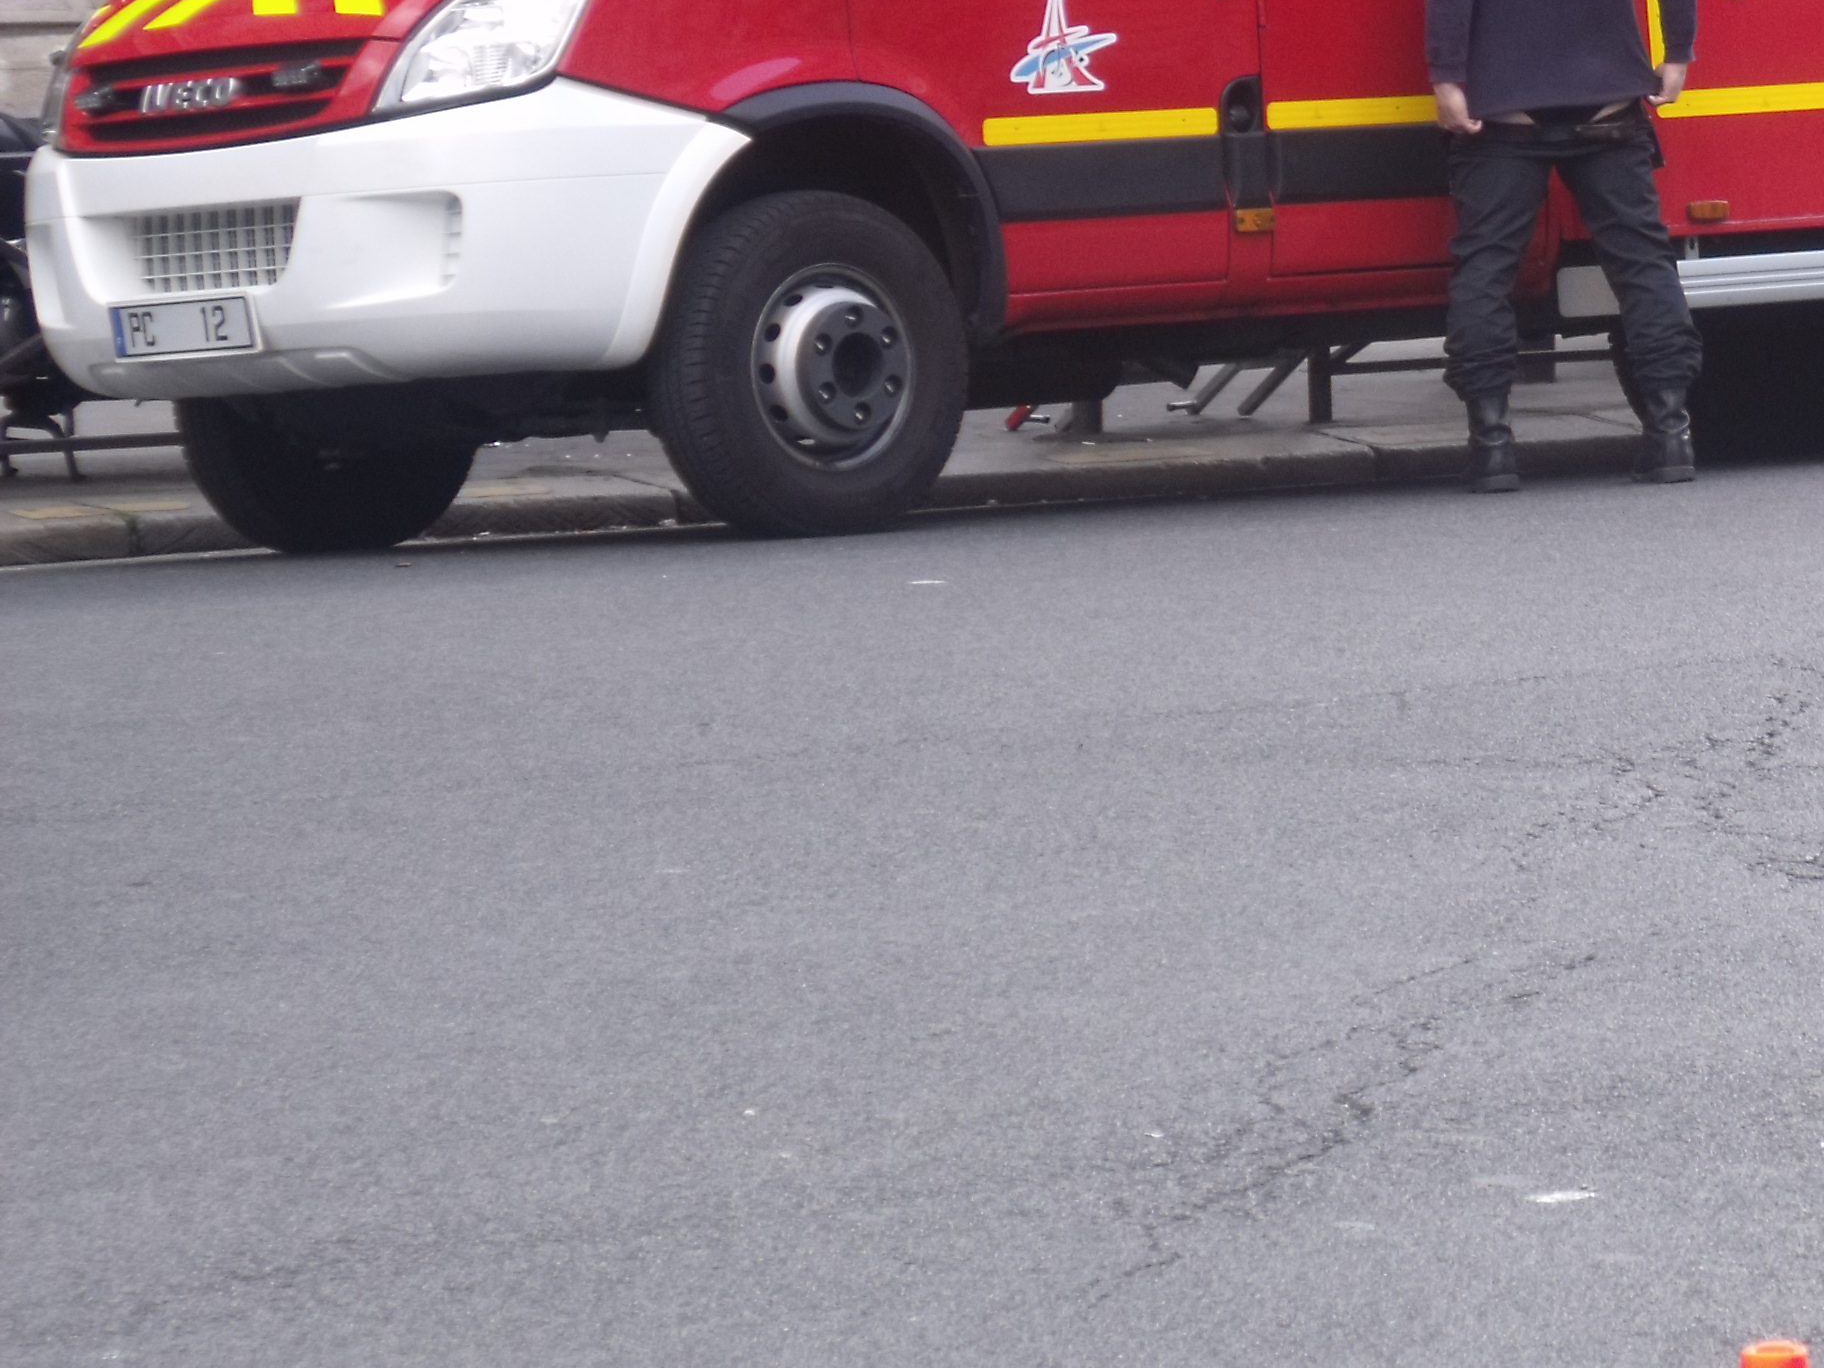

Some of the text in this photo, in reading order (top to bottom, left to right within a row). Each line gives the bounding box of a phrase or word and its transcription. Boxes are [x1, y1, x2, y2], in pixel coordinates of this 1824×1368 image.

[140, 77, 238, 114] IVECO
[128, 305, 228, 348] PC 12
